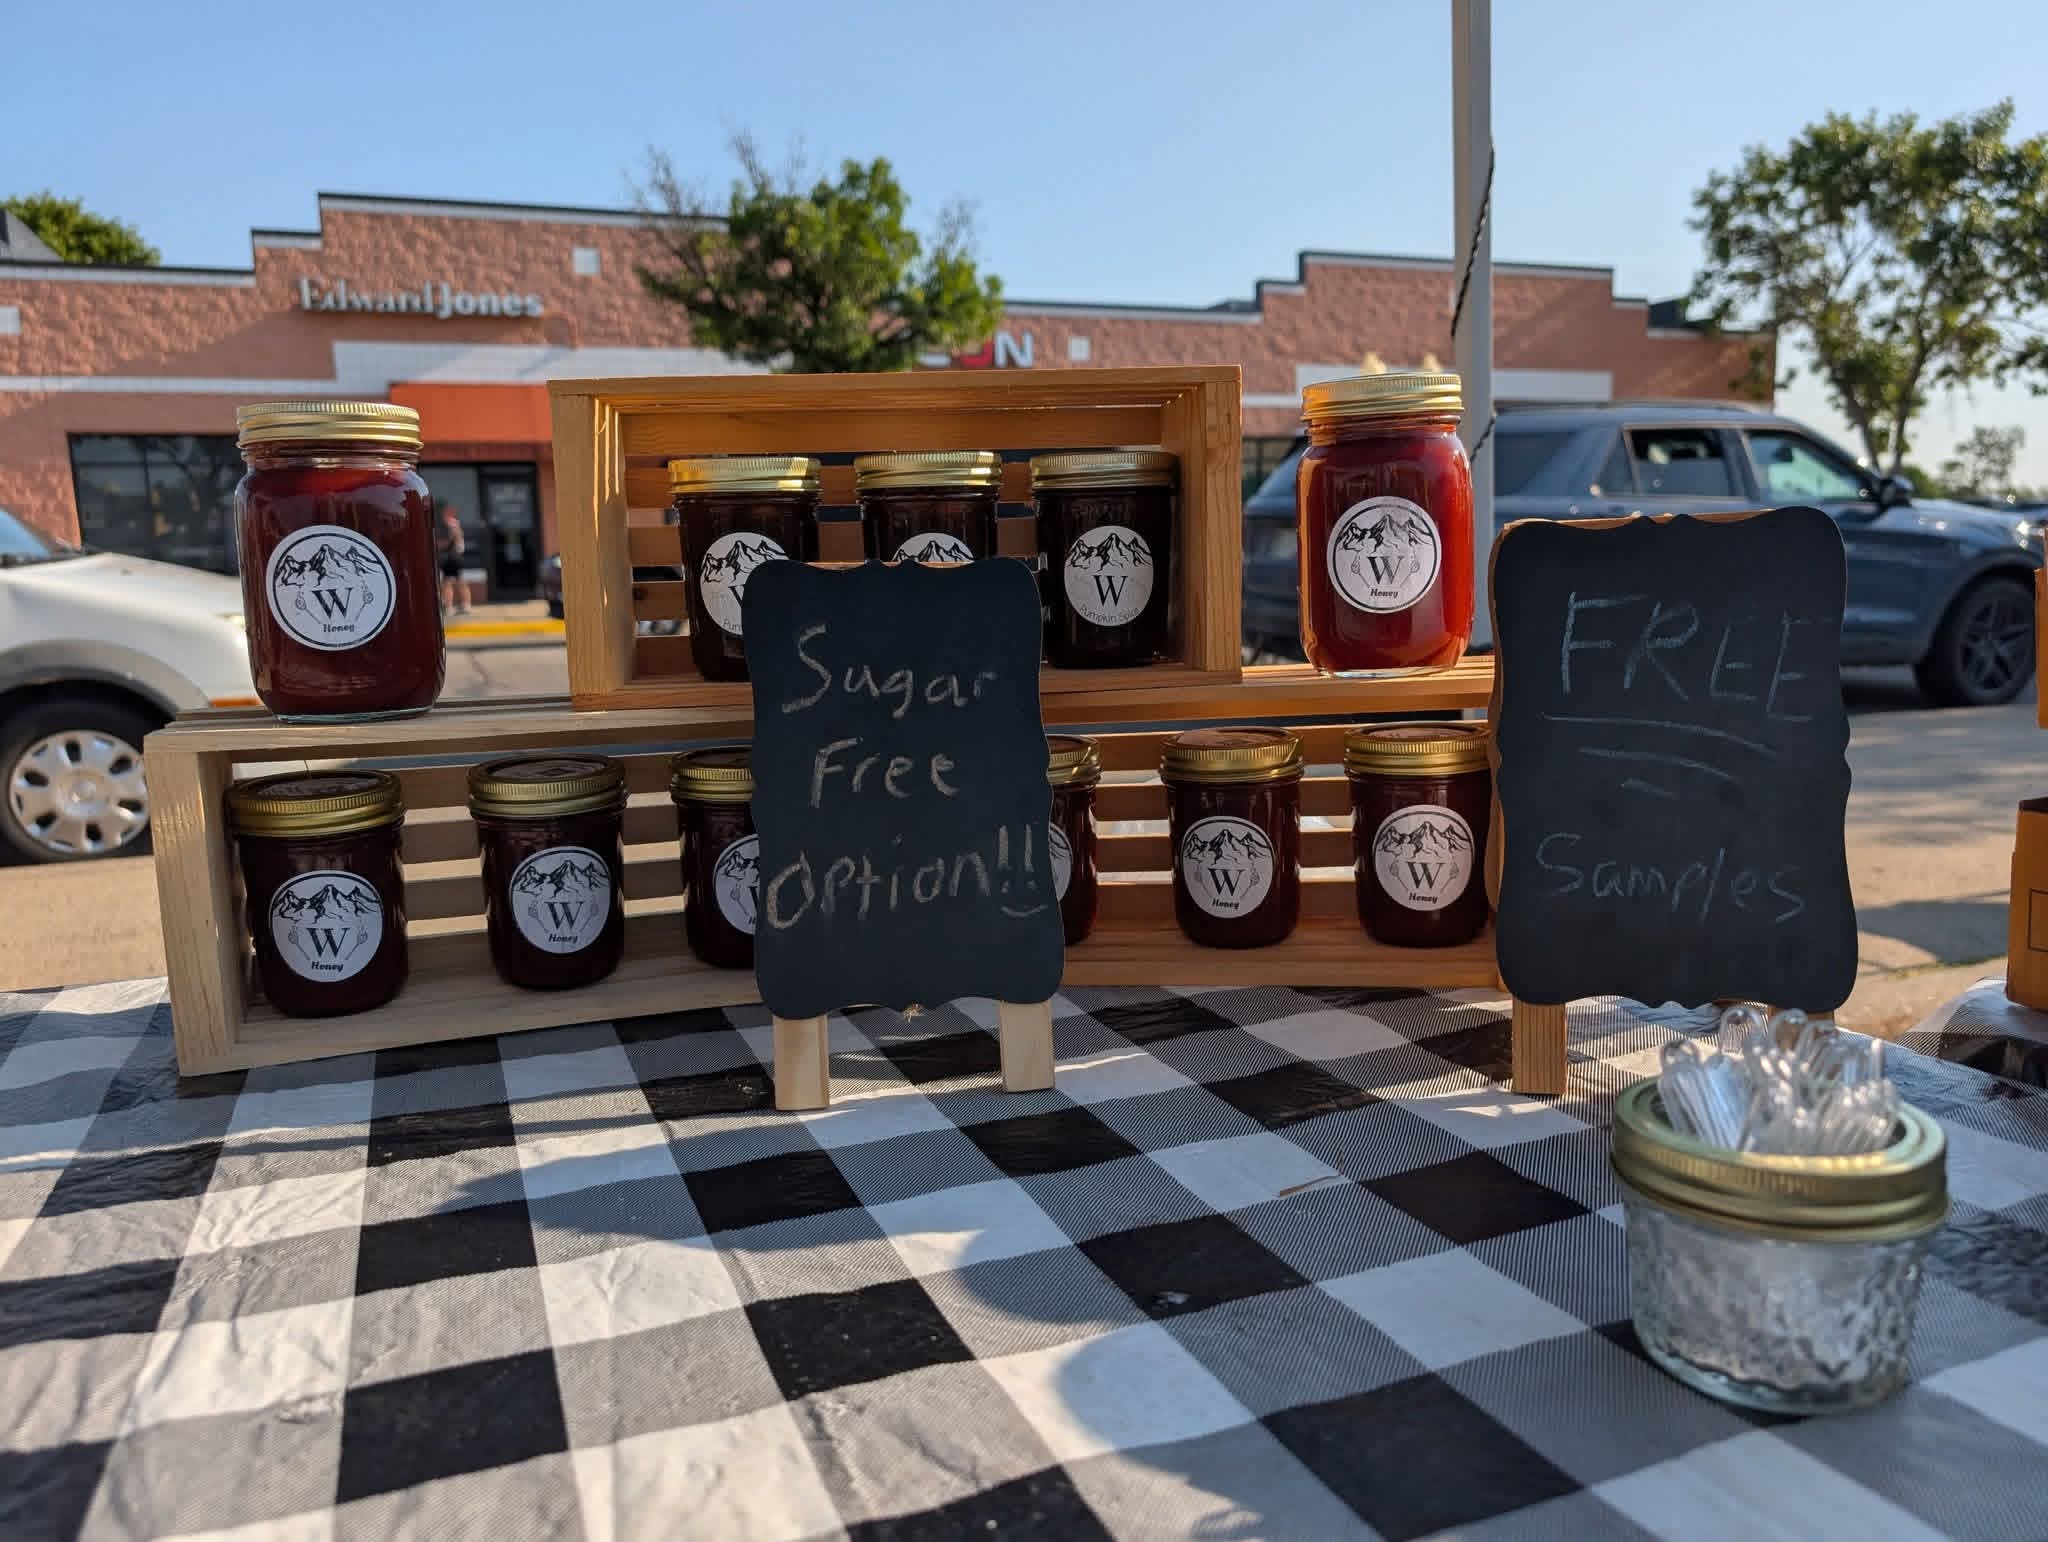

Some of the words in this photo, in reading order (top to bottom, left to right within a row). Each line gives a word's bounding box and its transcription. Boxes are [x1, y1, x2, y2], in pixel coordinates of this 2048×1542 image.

[300, 276, 434, 314] Edward
[437, 280, 545, 320] Jones
[1366, 556, 1404, 585] W
[311, 587, 353, 619] W
[1092, 575, 1128, 607] W
[1370, 588, 1399, 598] Honey
[781, 623, 997, 720] Sugar
[1560, 591, 1830, 722] FREE
[809, 736, 960, 809] Free
[1207, 867, 1248, 897] W
[1405, 861, 1448, 889] W
[1535, 831, 1806, 924] Samples
[1212, 898, 1241, 910] Honey
[1408, 892, 1439, 905] Honey
[543, 901, 585, 930] W
[305, 927, 351, 958] W
[548, 933, 579, 944] Honey
[311, 960, 344, 972] Honey
